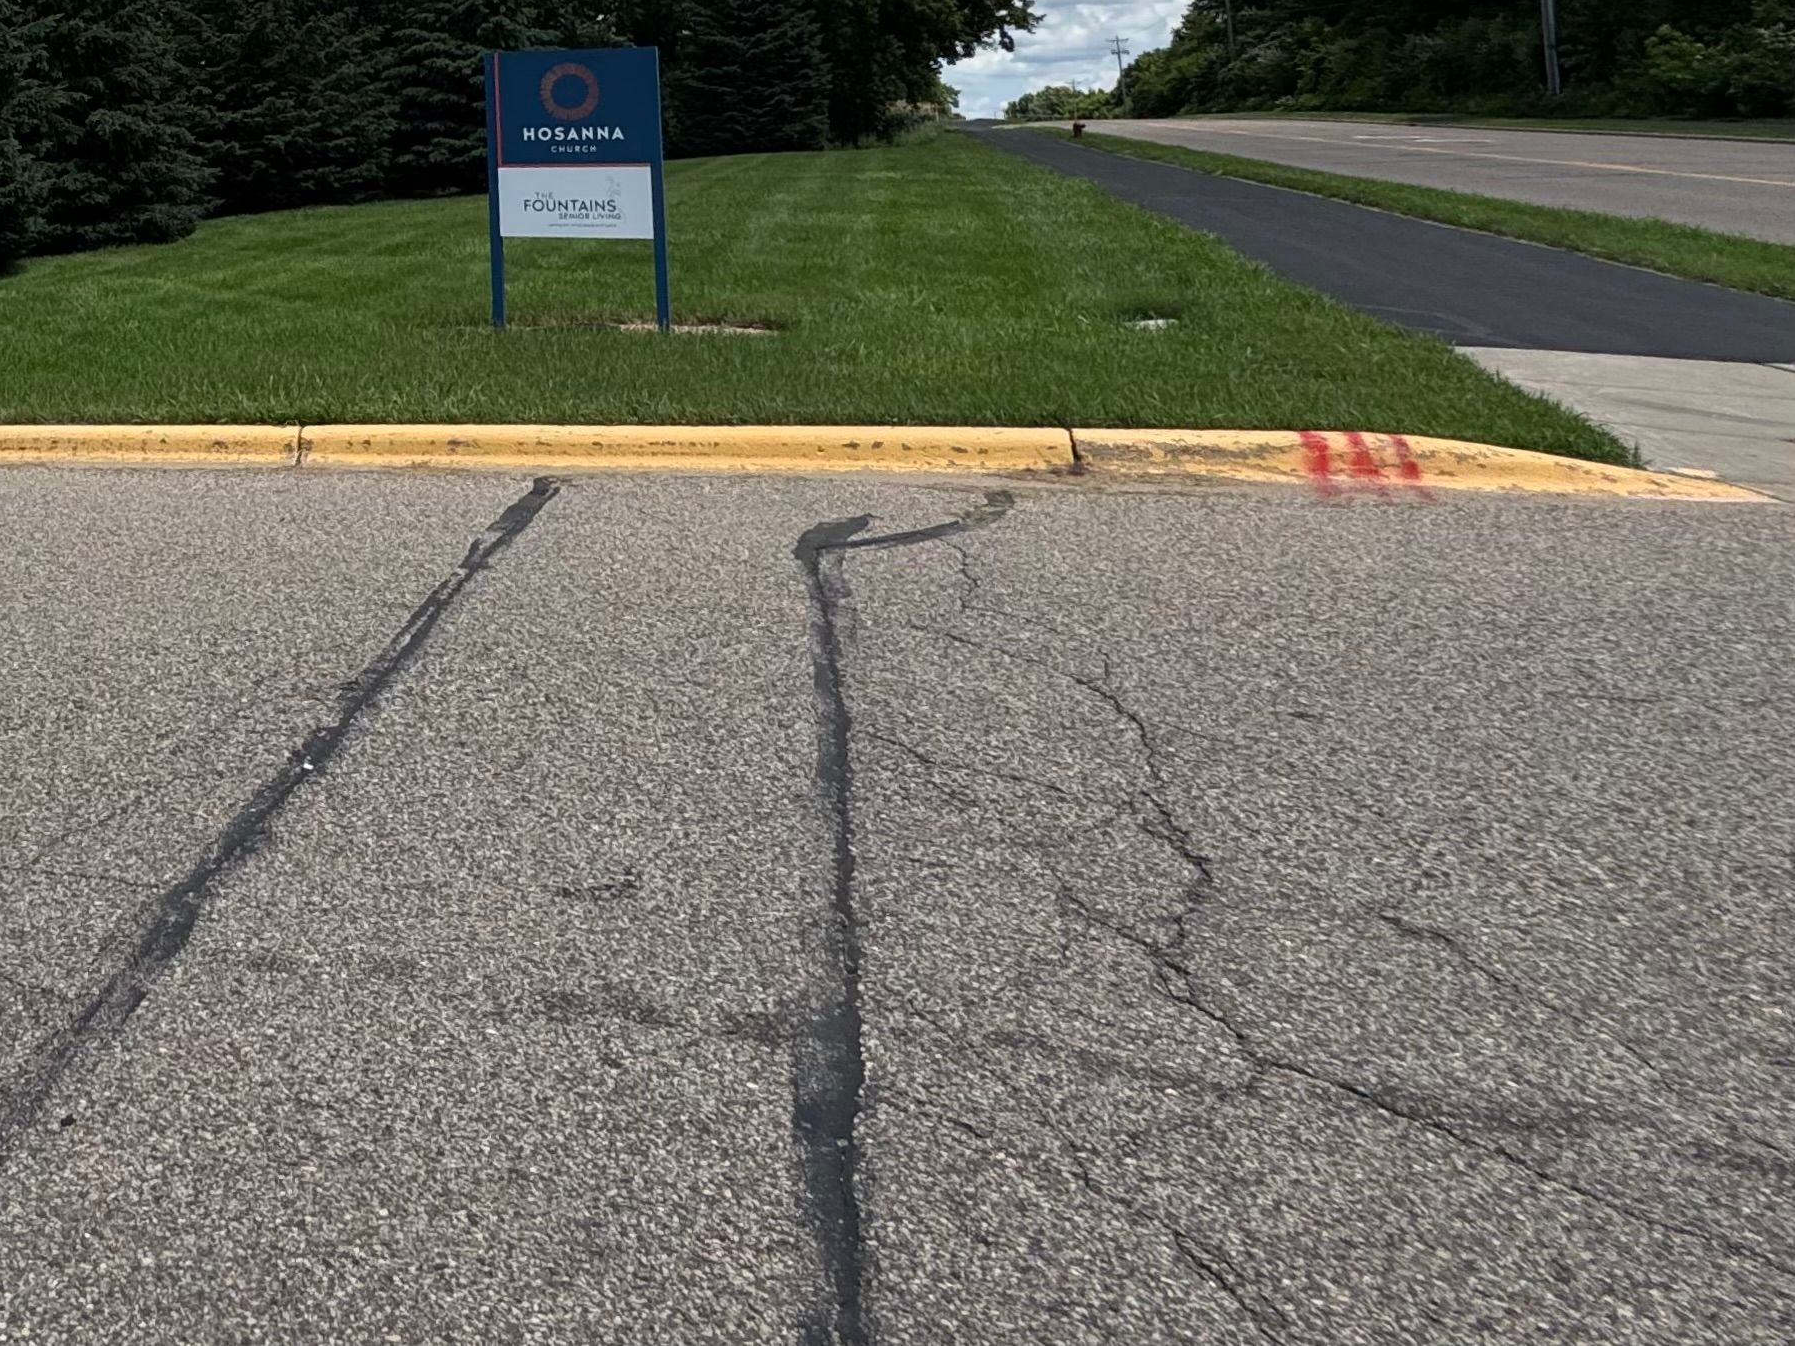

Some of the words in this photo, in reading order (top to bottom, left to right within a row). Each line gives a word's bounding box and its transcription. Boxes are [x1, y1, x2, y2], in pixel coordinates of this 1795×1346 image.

[523, 126, 625, 141] HOSANNA
[551, 145, 597, 153] CHURCH
[523, 199, 617, 212] FOUNTAINS
